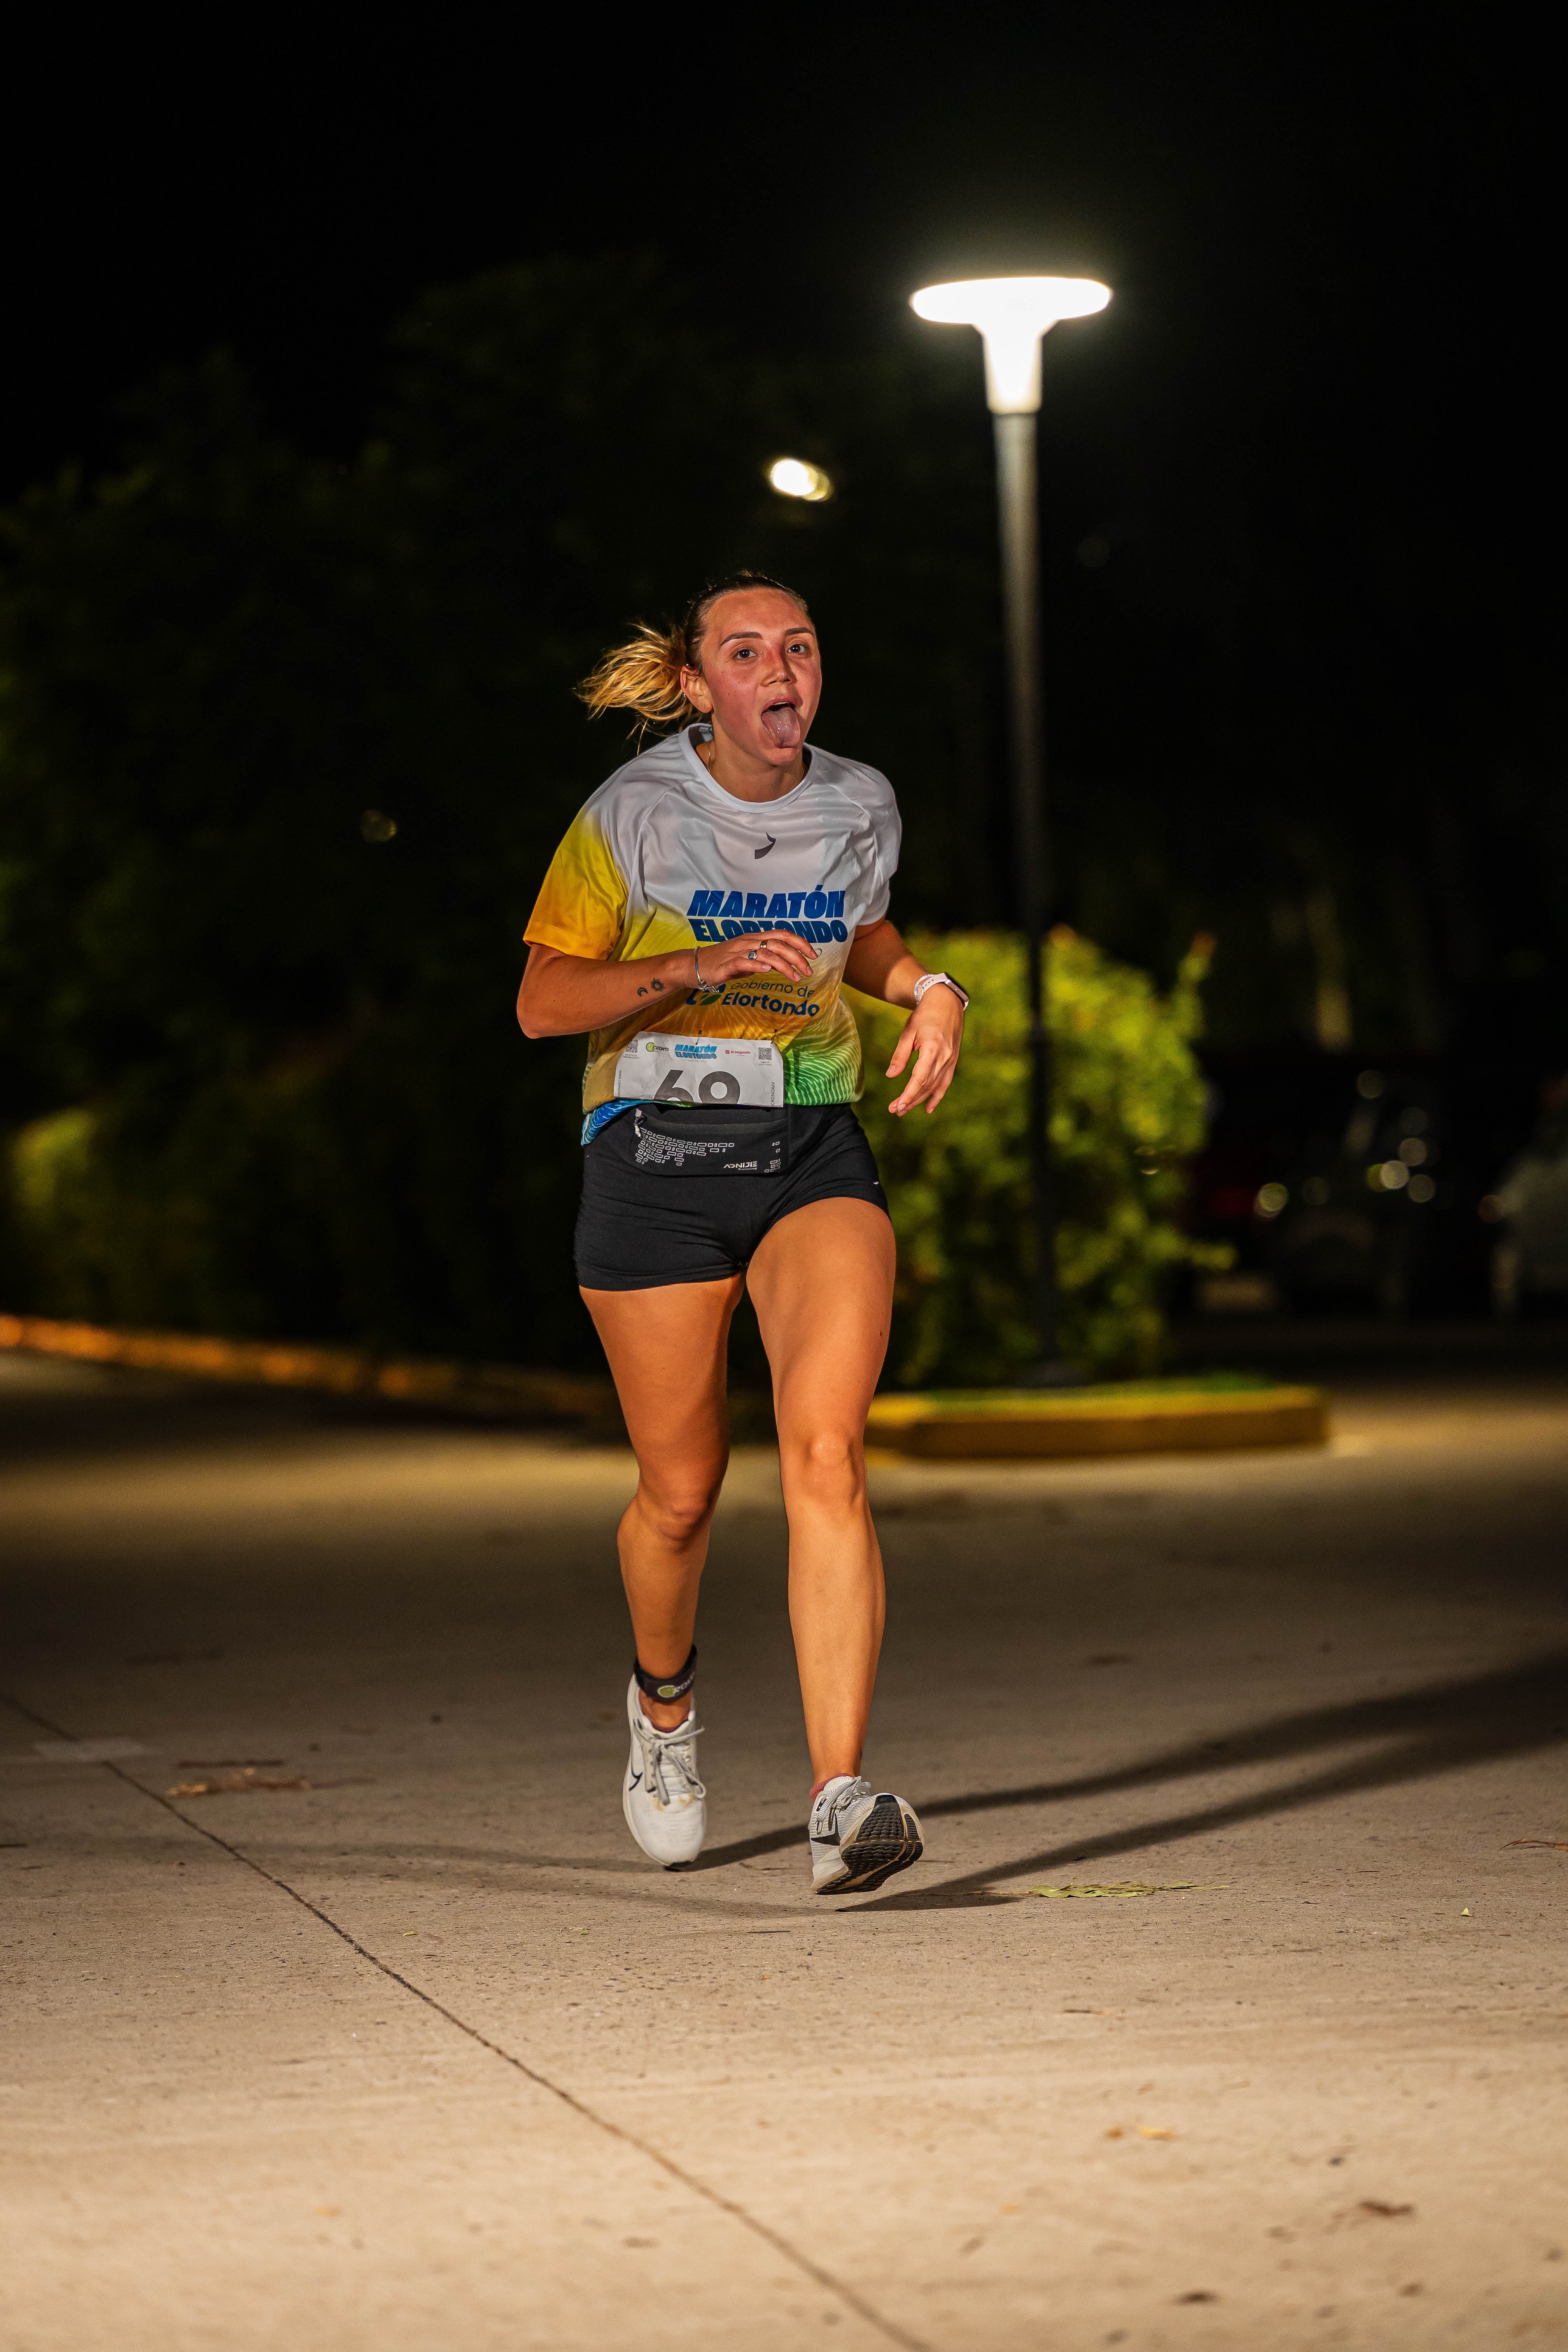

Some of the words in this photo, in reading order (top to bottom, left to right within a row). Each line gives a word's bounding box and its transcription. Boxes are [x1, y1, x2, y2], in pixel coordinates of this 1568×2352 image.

[686, 884, 846, 919] MARATÓN
[730, 981, 793, 994] Gobierno
[797, 986, 815, 998] de
[721, 992, 820, 1017] Elortondo
[674, 1044, 718, 1053] MARATÓN
